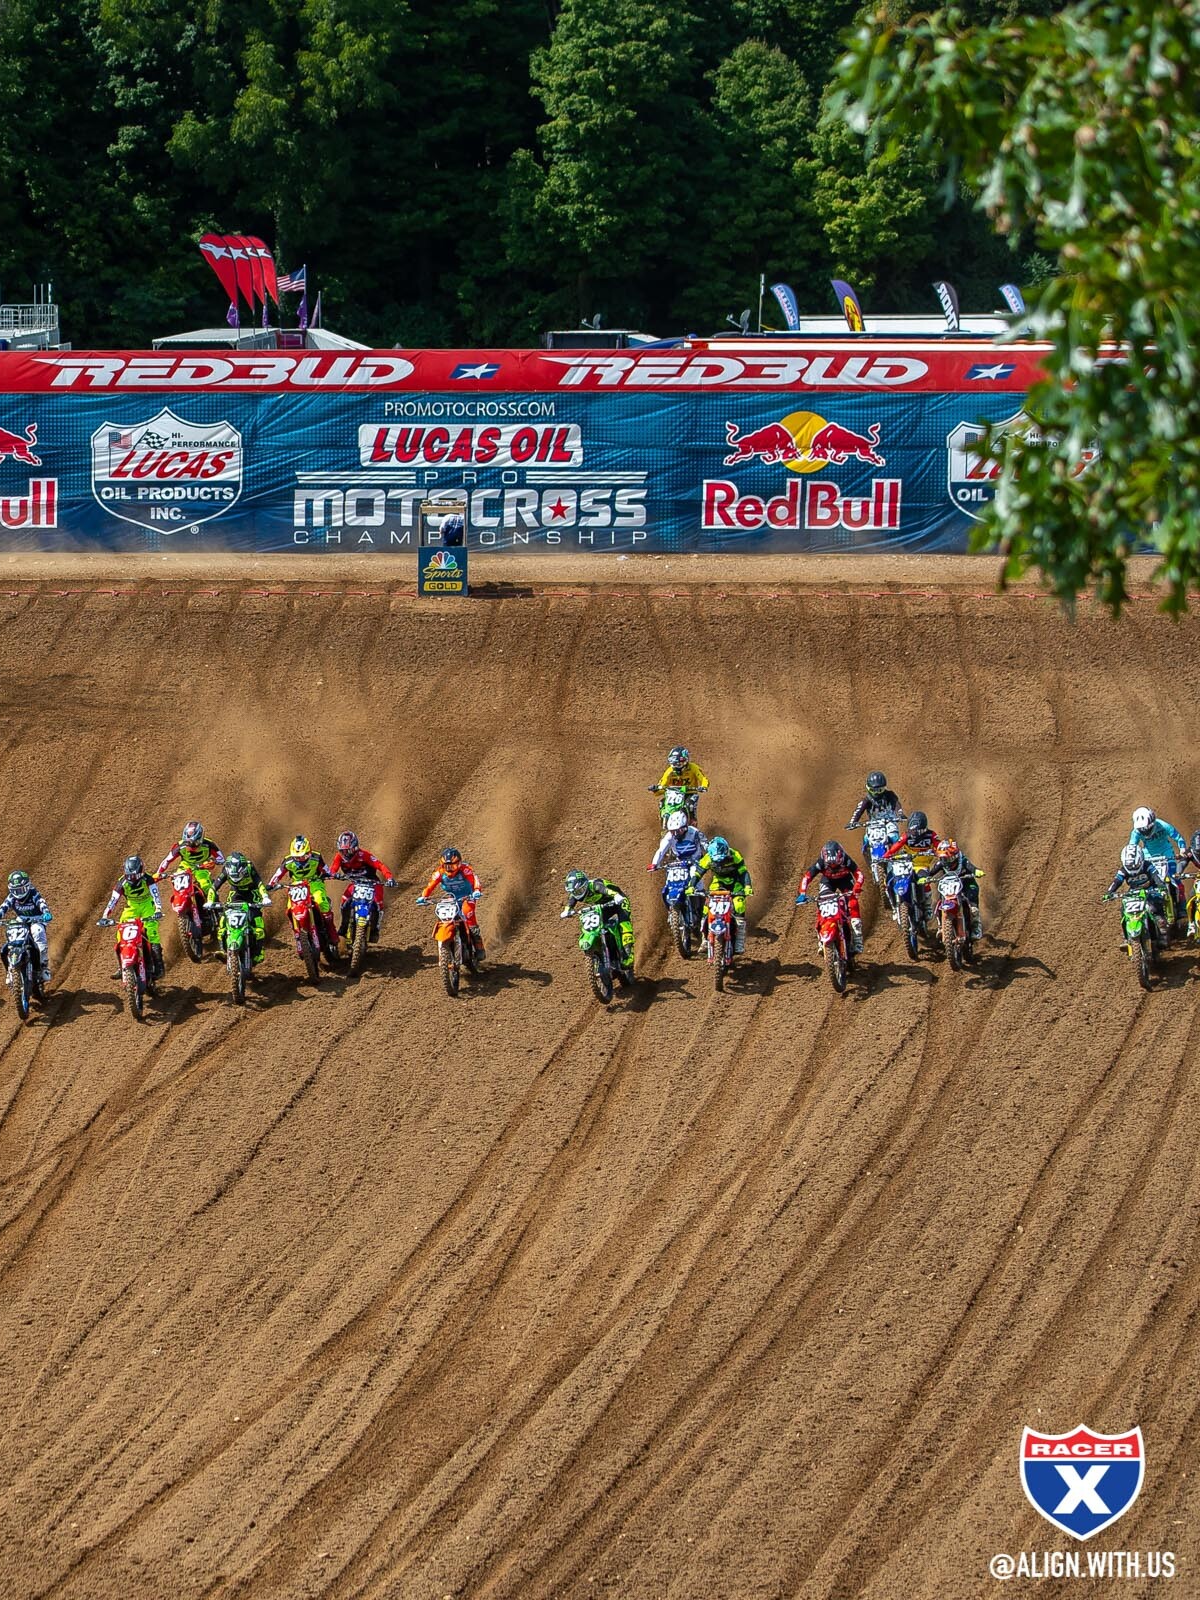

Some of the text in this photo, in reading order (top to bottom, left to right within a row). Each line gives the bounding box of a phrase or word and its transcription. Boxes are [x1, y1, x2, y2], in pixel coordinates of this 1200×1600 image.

[32, 358, 414, 387] REDBUD
[540, 357, 929, 386] REDBUD
[384, 402, 555, 417] PROMOTOCROSS.COM
[369, 428, 573, 463] LUCAS OIL
[110, 451, 234, 479] LUCAS
[425, 471, 518, 484] PRO
[101, 487, 235, 501] OIL PRODUCTS
[956, 488, 989, 502] OIL
[701, 478, 902, 530] Red Bull
[150, 508, 187, 521] INC.
[294, 531, 648, 545] CHAMPONSHIP
[422, 567, 464, 580] Sports
[428, 582, 458, 590] GOLD
[907, 839, 931, 847] FXR
[353, 887, 375, 900] 355
[709, 901, 730, 914] 247
[1125, 901, 1145, 912] 221
[582, 914, 600, 930] 29
[8, 928, 28, 941] 32
[122, 925, 139, 940] 6
